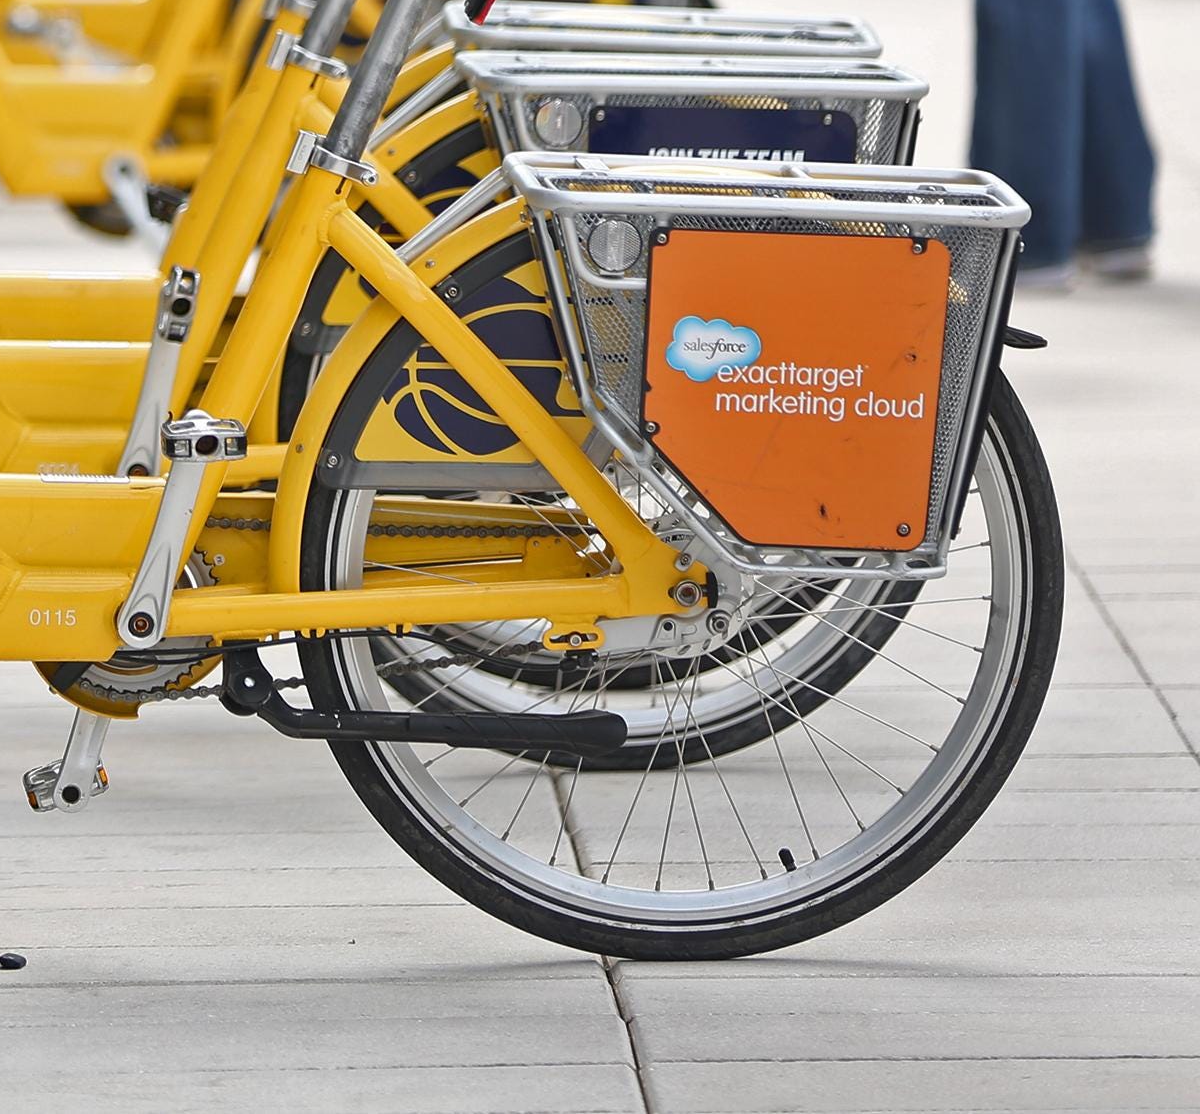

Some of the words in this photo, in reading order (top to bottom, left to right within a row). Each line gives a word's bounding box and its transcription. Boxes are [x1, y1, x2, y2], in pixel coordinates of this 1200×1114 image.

[683, 337, 747, 359] salesforce
[717, 361, 864, 393] exacttarget
[715, 388, 846, 422] marketing
[854, 391, 925, 419] cloud
[29, 608, 78, 627] 0115
